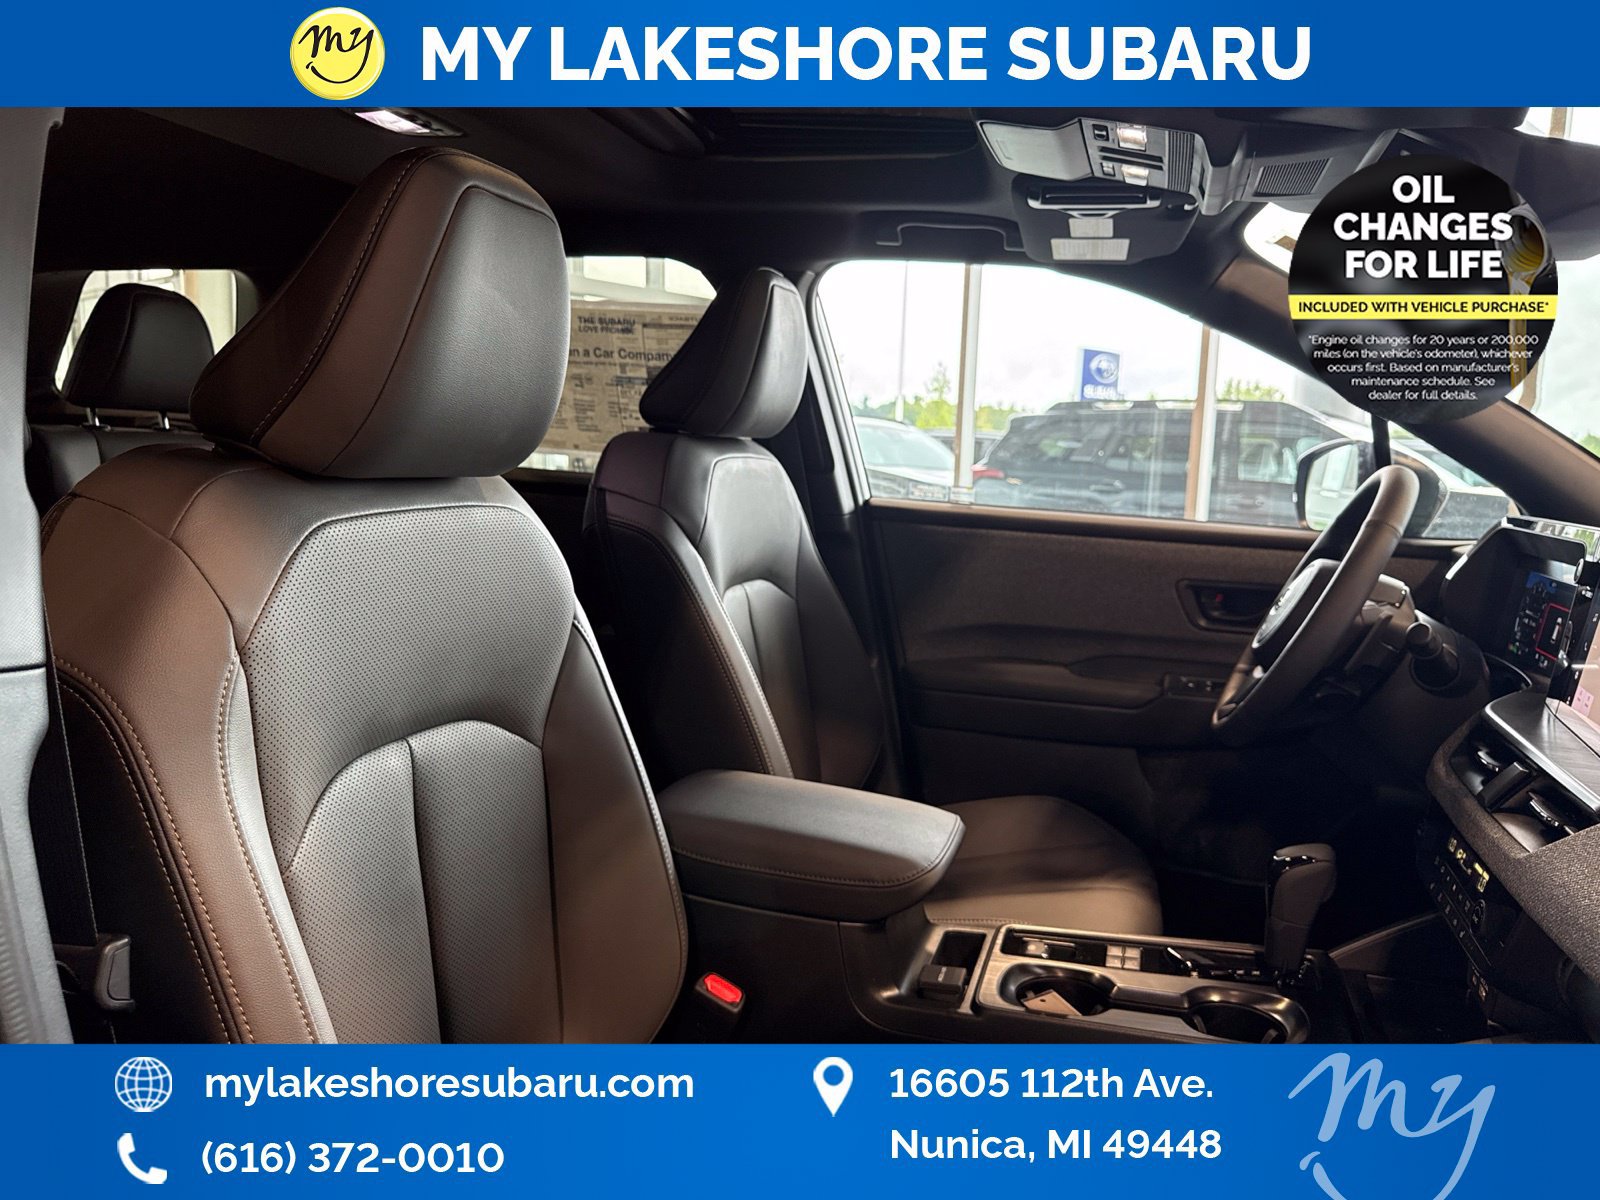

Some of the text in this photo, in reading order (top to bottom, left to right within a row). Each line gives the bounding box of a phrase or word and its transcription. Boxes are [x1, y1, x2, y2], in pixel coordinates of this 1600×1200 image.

[578, 316, 636, 326] THE SUBARU
[578, 325, 597, 334] LOVE
[593, 347, 614, 359] Car
